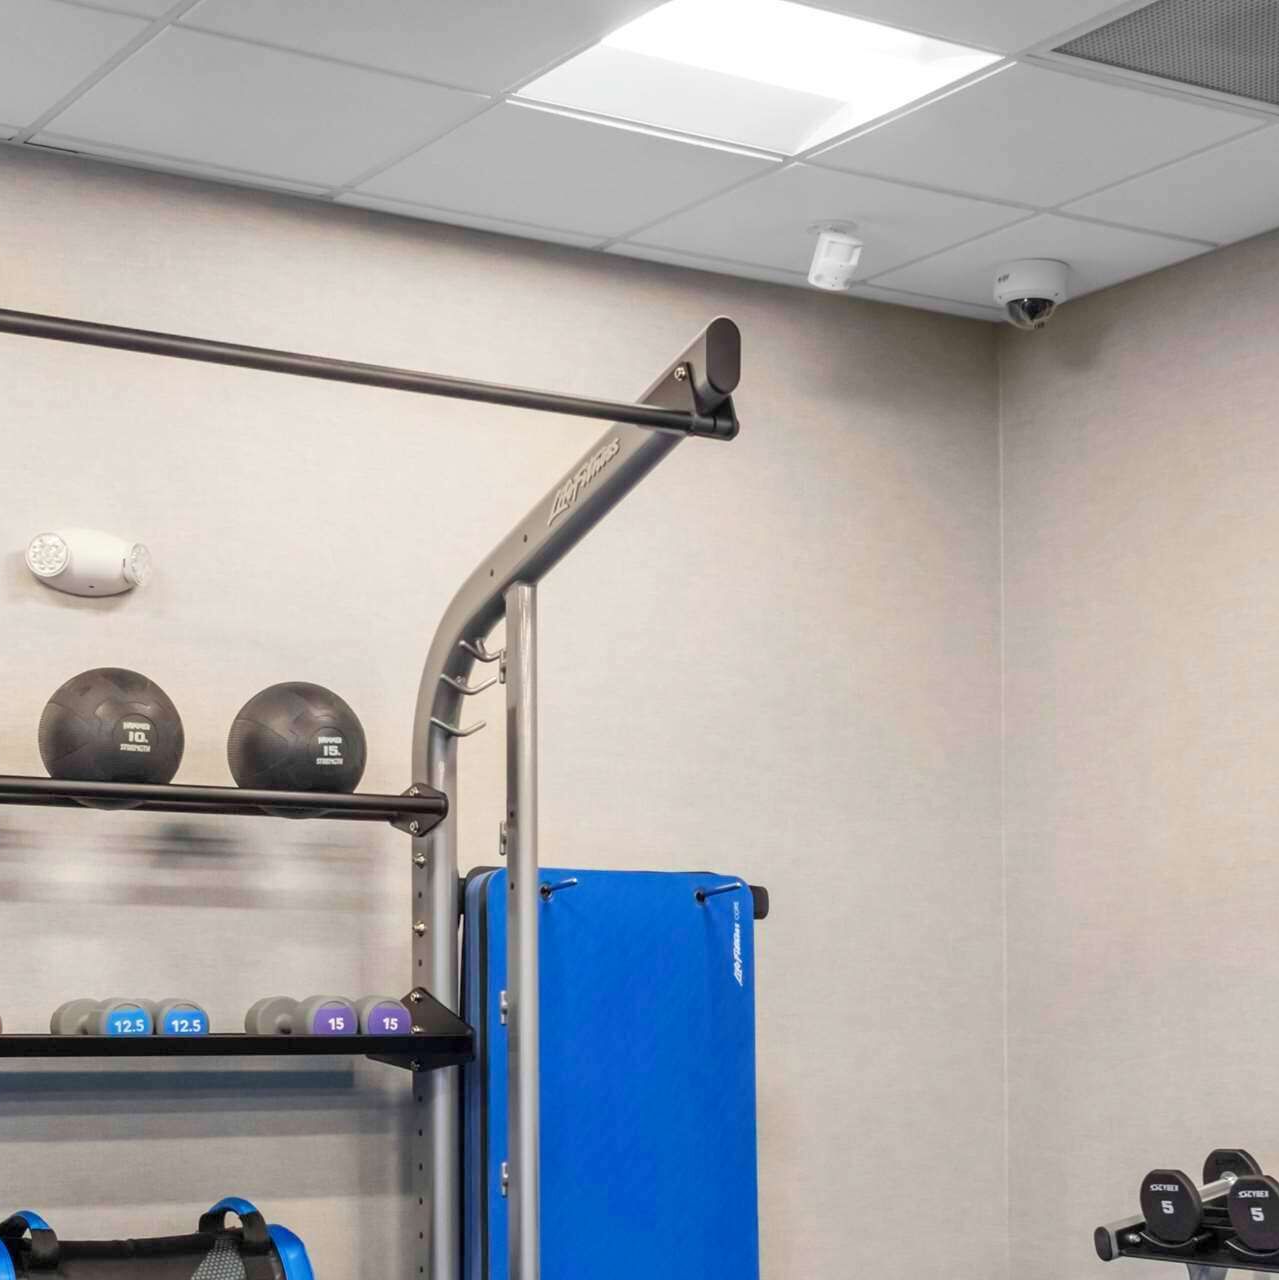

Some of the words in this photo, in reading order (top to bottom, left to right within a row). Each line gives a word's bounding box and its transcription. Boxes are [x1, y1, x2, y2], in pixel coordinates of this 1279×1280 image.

[114, 1018, 144, 1034] 12.5
[171, 1018, 201, 1034] 12.5
[327, 1015, 345, 1031] 15
[382, 1016, 399, 1032] 15
[1161, 1200, 1175, 1215] 5
[1250, 1208, 1265, 1222] 5
